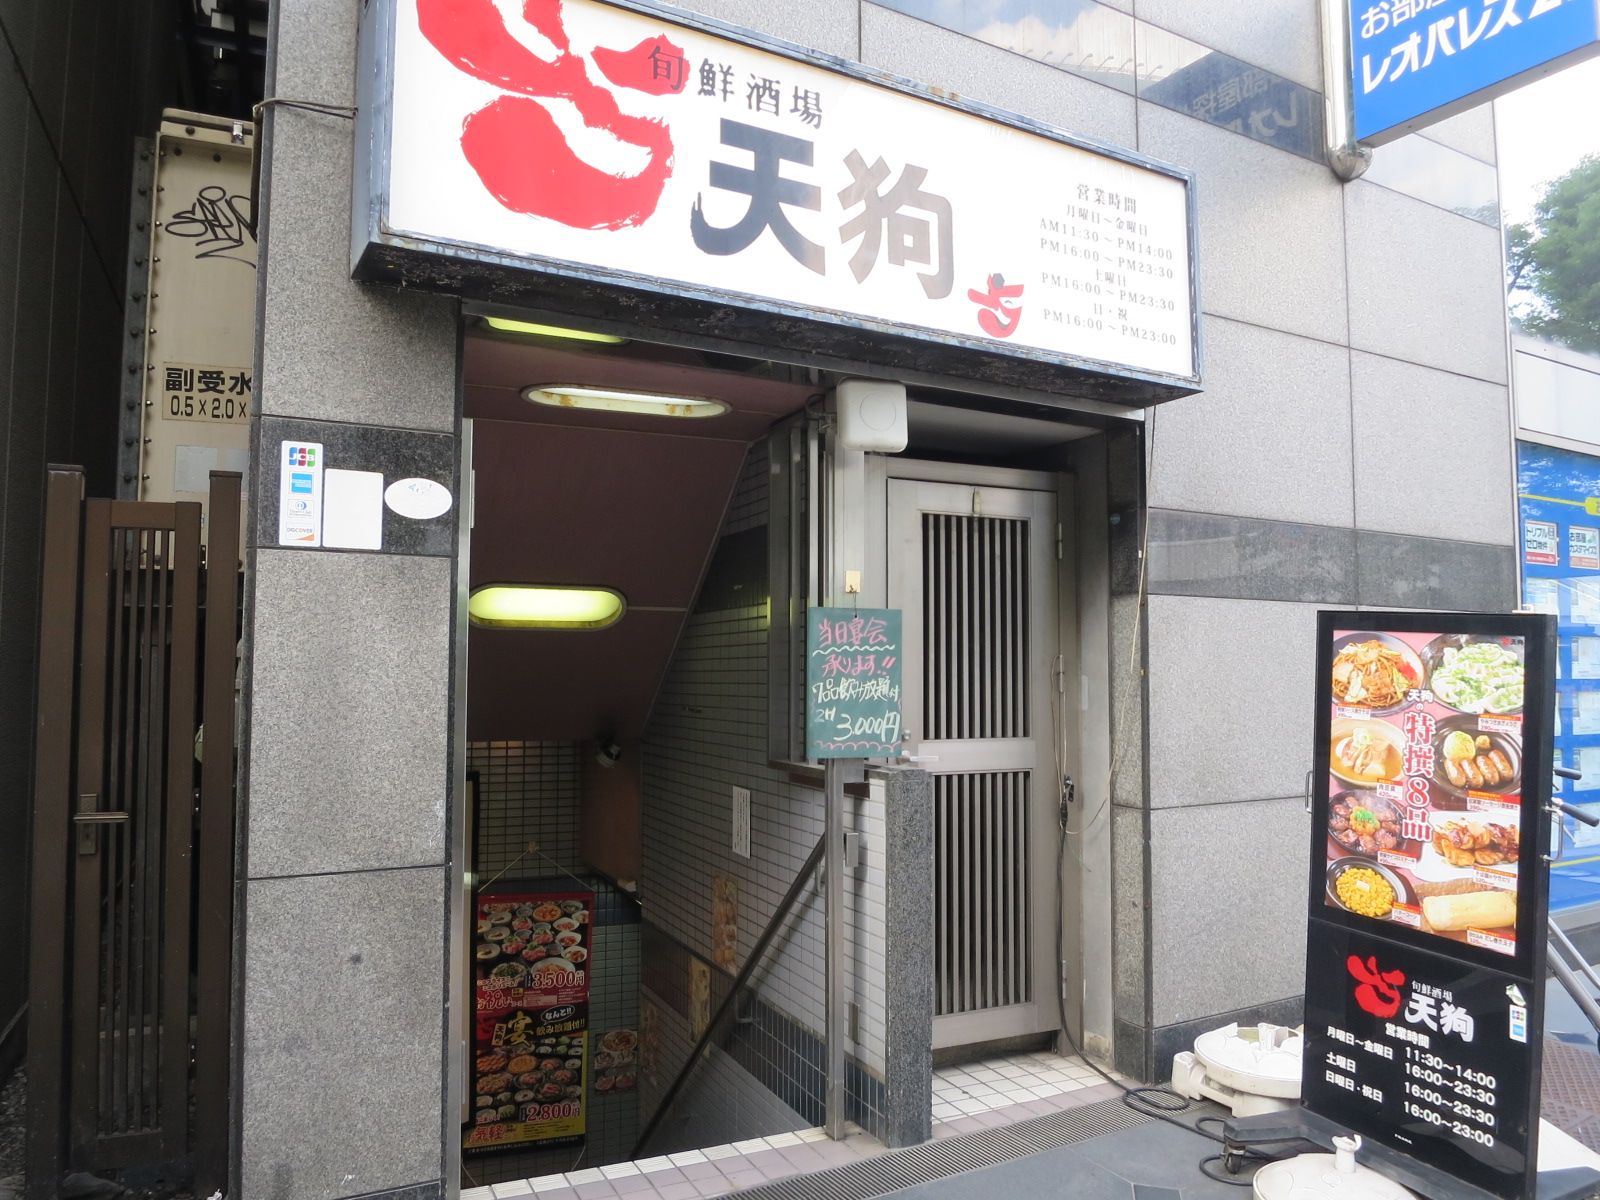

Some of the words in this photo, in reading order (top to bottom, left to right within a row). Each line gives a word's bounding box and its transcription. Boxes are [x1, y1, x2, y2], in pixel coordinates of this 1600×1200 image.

[647, 46, 823, 129] 旬鮮酒場
[690, 117, 954, 300] 天狗
[1076, 184, 1137, 215] 営業時間
[1096, 268, 1127, 288] 土曜日
[1411, 980, 1453, 1003] 旬鮮酒場
[1404, 992, 1475, 1043] 天狗
[1385, 1022, 1430, 1050] 営業時間
[1326, 1051, 1357, 1074] 土曜日
[1325, 1069, 1383, 1104] 日曜日・祝日
